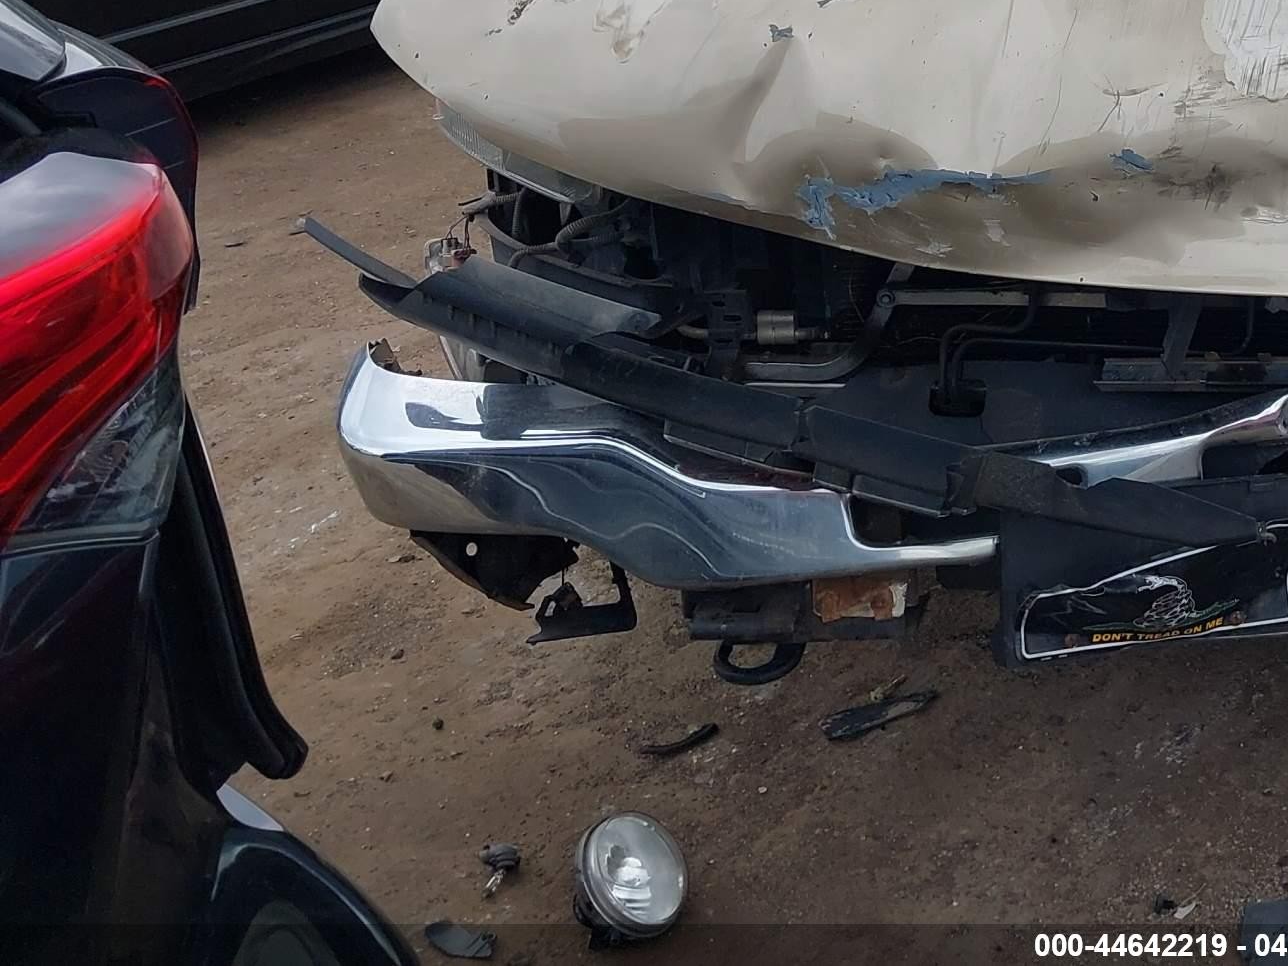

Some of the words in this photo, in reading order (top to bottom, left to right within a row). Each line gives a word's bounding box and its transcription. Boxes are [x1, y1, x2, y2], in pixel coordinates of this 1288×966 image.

[1092, 632, 1134, 642] DON'T
[1136, 629, 1180, 641] TREAD
[1184, 624, 1203, 635] ON
[1205, 616, 1225, 630] ME
